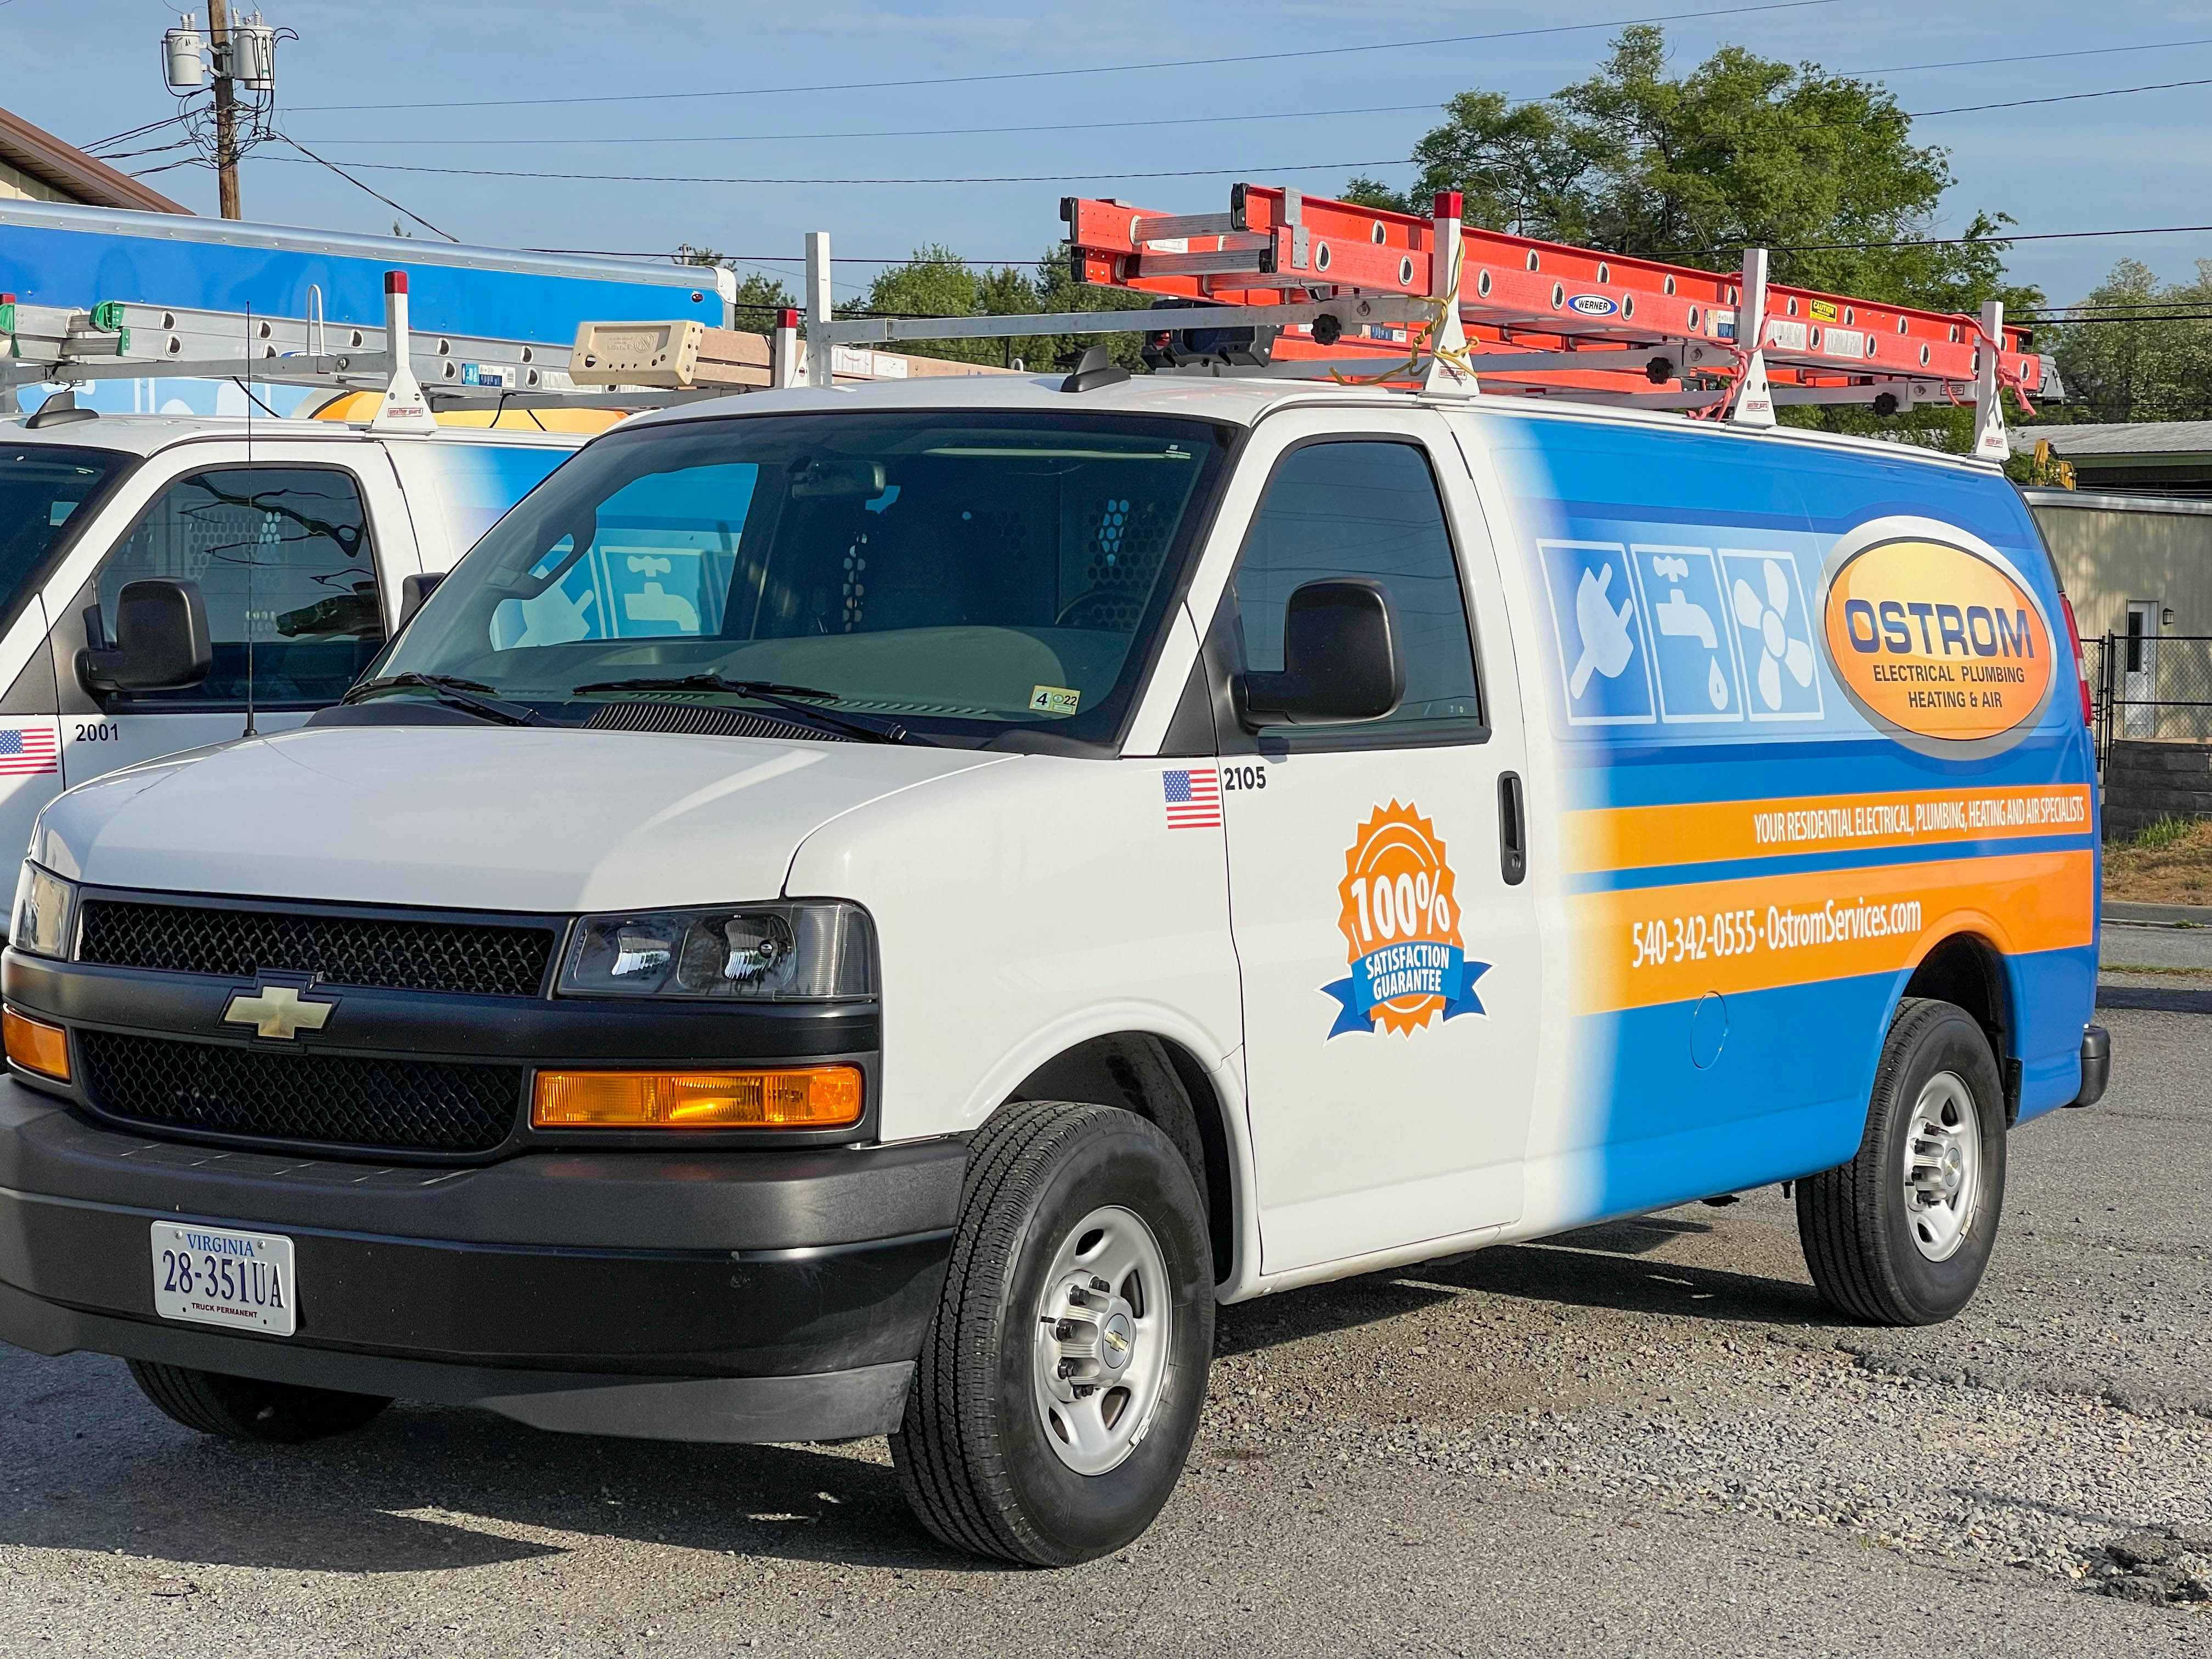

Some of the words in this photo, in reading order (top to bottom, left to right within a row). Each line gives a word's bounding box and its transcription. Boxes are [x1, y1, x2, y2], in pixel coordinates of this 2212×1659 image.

[1578, 300, 1608, 311] WERNER
[1813, 301, 1834, 314] CAUTION
[1845, 599, 2034, 658] OSTROM
[1872, 664, 1955, 682] ELECTRICAL
[1961, 666, 2025, 682] PLUMBING
[1036, 692, 1048, 706] 4
[1063, 695, 1077, 706] 22
[1908, 691, 1966, 708] HEATING
[1970, 692, 1978, 708] &
[1981, 692, 2003, 708] AIR
[75, 723, 119, 742] 2001
[1223, 766, 1266, 791] 2105
[1753, 812, 1785, 844] YOUR
[1787, 808, 1854, 841] RESIDENTIAL
[1855, 804, 1915, 837] ELECTRICAL,
[1916, 801, 1968, 833] PLUMBING,
[1968, 799, 2006, 827] HEATING
[2007, 798, 2025, 825] AND
[2026, 798, 2040, 824] AIR
[2041, 796, 2085, 823] SPECIALISTS
[1350, 868, 1451, 941] 100%
[1632, 909, 1756, 968] 540-342-0555
[1767, 895, 1921, 951] OstromServices.com
[1365, 945, 1449, 980] SATISFACTION
[1373, 969, 1442, 1001] GUARANTEE
[187, 1234, 255, 1257] VIRGINIA
[163, 1249, 285, 1308] 28-351UA
[191, 1302, 215, 1312] TRUCK
[217, 1306, 257, 1318] PERMANENT
